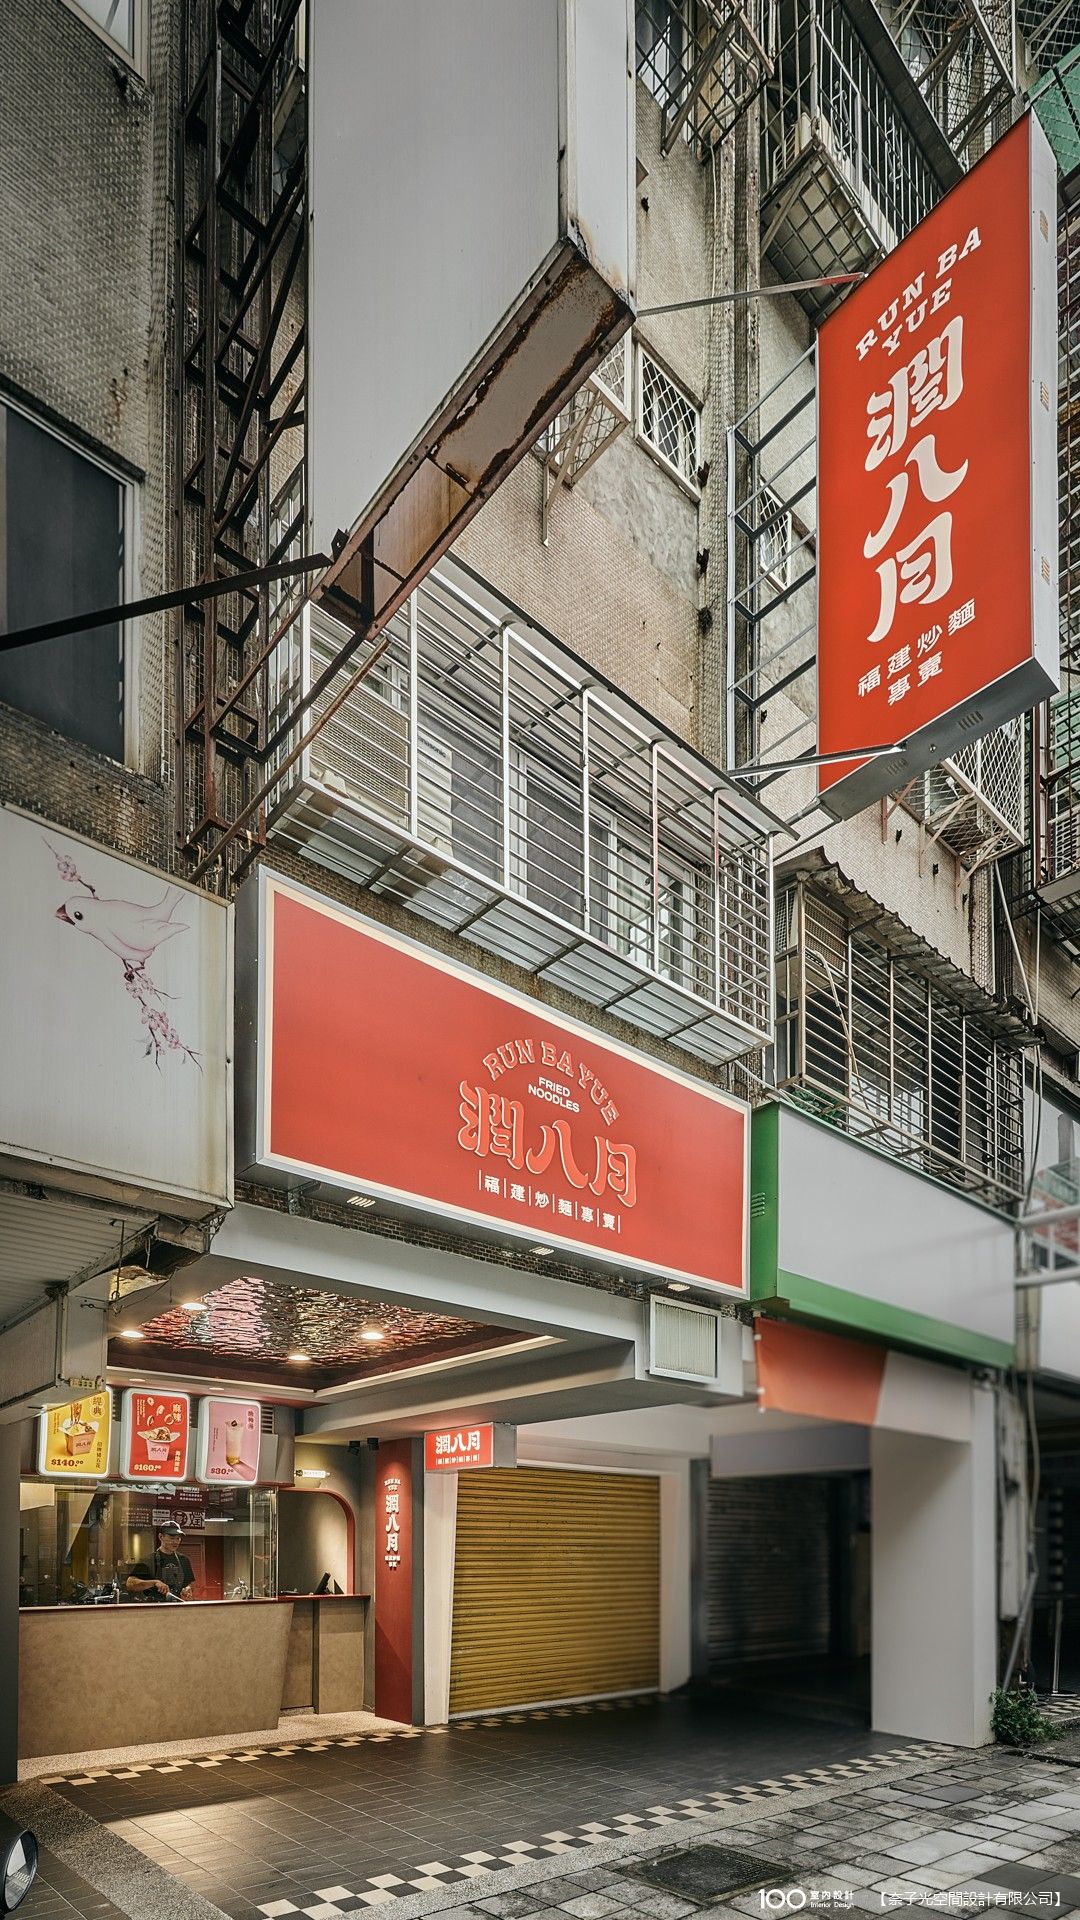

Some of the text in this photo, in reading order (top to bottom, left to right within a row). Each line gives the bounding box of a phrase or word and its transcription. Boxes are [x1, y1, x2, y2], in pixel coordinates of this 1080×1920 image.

[855, 226, 982, 361] RUN BA
[881, 277, 952, 357] YUE
[863, 315, 969, 643] 潤八月
[858, 598, 976, 697] 福建炒麵
[887, 651, 943, 705] 專賣
[482, 1038, 621, 1127] RUN BA YUE
[528, 1083, 581, 1114] NOODLES
[538, 1076, 571, 1098] FRIED
[458, 1080, 637, 1208] 潤八月
[484, 1174, 616, 1231] 福建炒麵專賣
[435, 1430, 481, 1455] 潤八月
